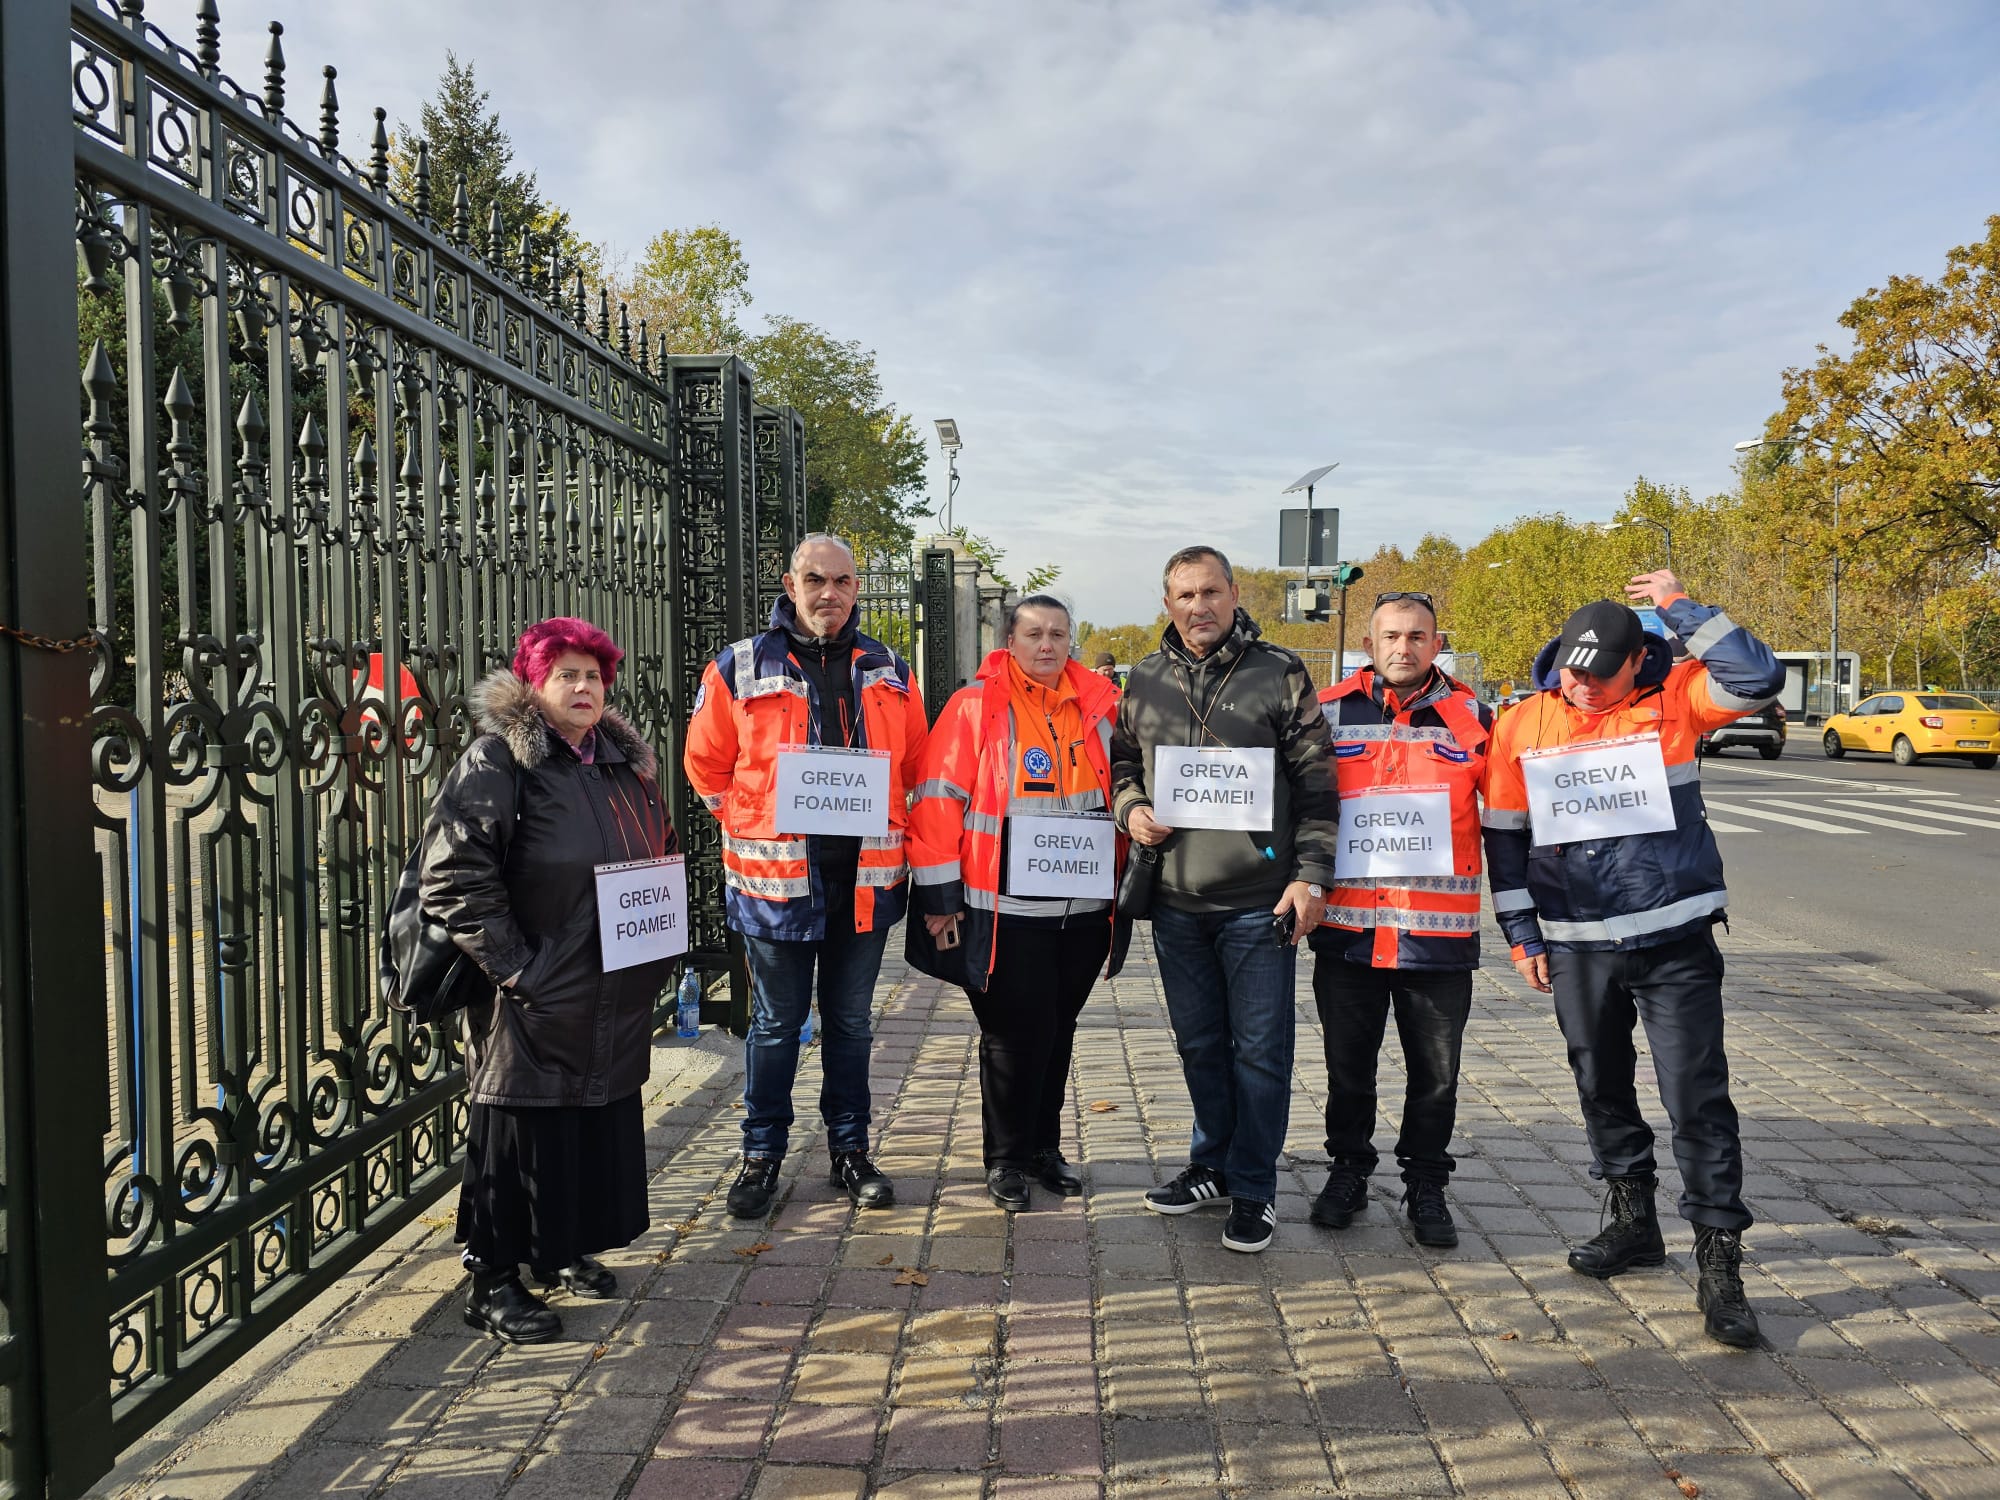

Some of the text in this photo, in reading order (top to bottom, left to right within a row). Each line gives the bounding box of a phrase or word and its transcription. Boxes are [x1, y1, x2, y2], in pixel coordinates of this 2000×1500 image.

[801, 771, 868, 788] GREVA
[1180, 764, 1249, 780] GREVA
[1554, 765, 1637, 789] GREVA
[794, 795, 872, 813] FOAMEI!
[1173, 788, 1255, 806] FOAMEI!
[1552, 790, 1648, 816] FOAMEI!
[1353, 811, 1425, 829] GREVA
[1033, 834, 1095, 851] GREVA
[1348, 837, 1432, 855] FOAMEI!
[1027, 858, 1099, 876] FOAMEI!
[619, 885, 672, 910] GREVA
[615, 912, 676, 941] FOAMEI!
